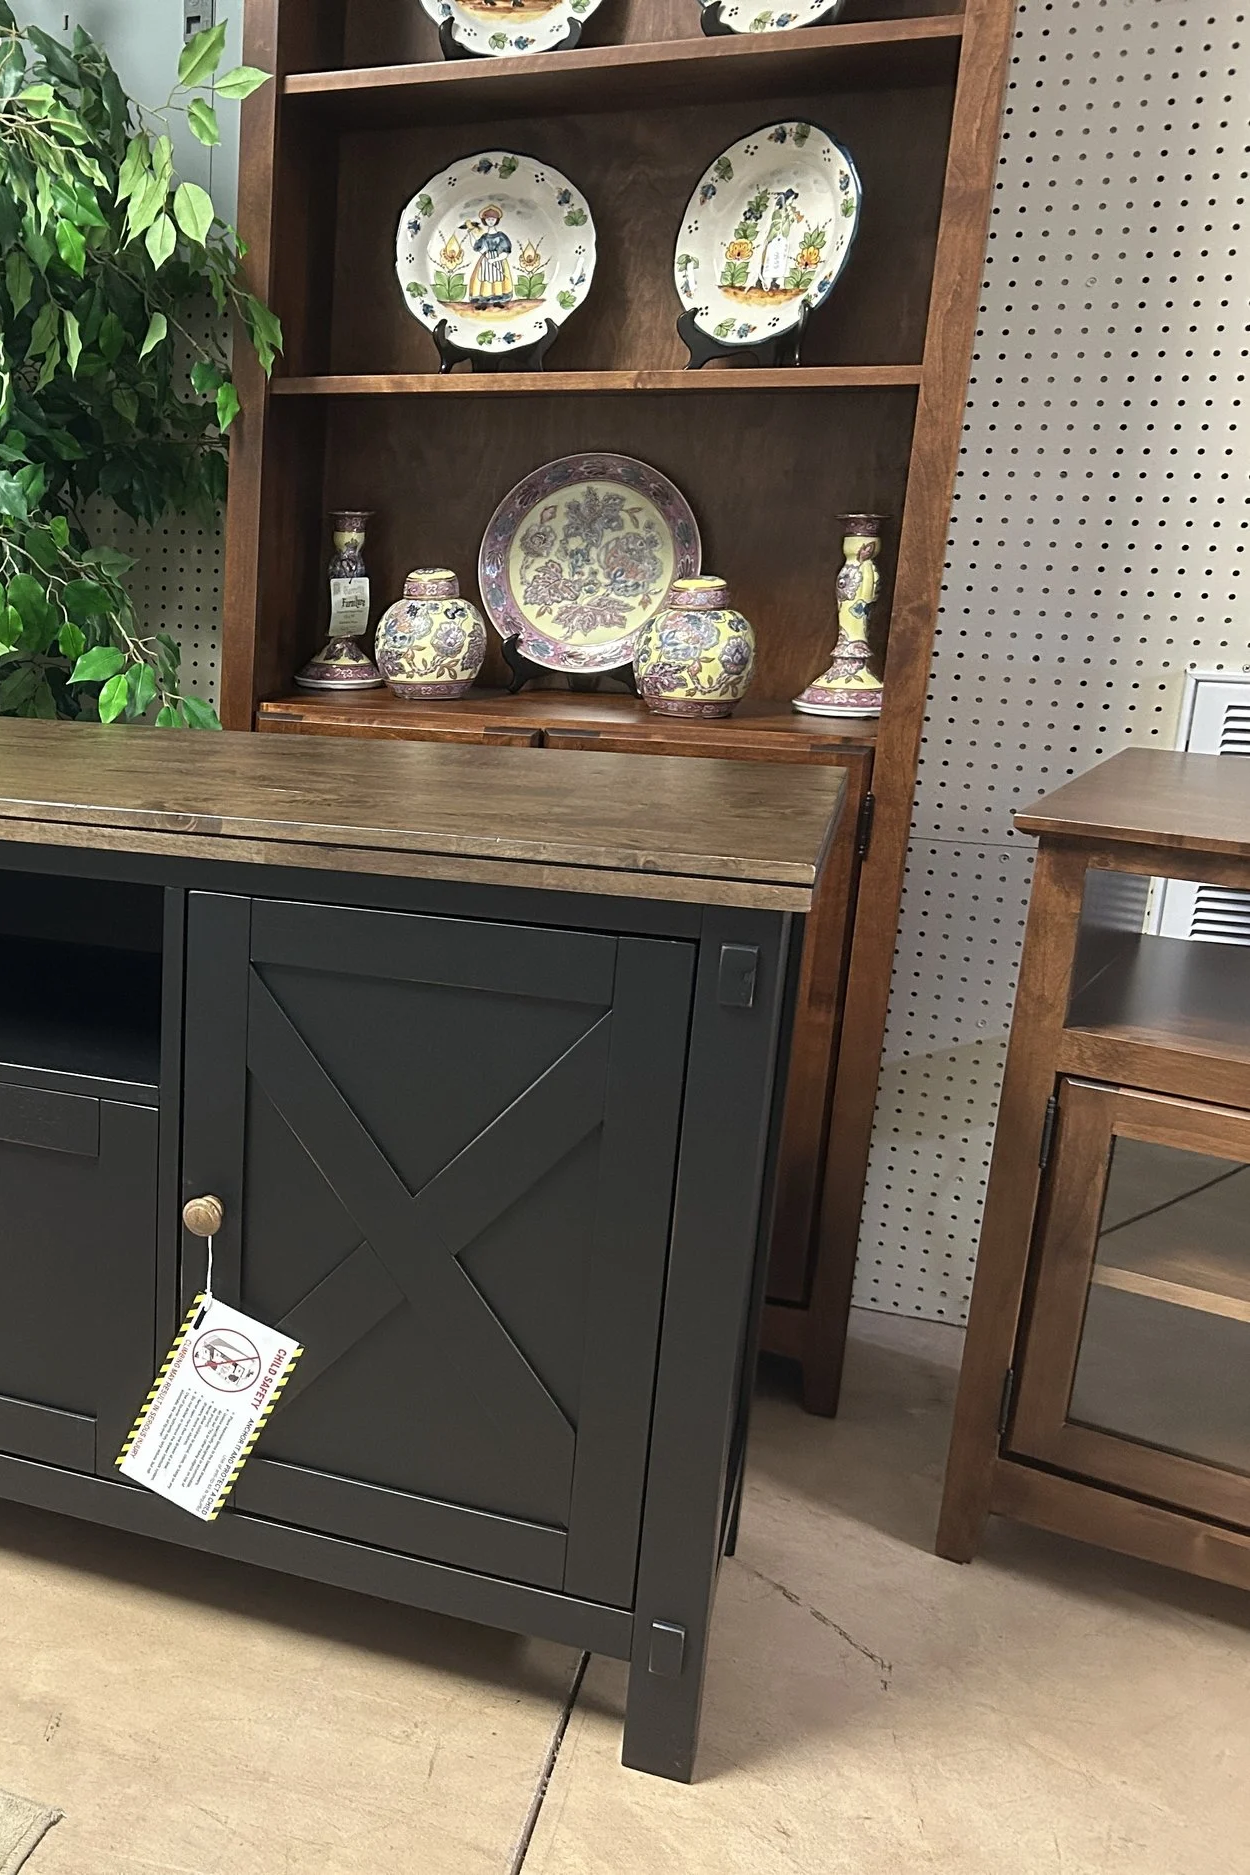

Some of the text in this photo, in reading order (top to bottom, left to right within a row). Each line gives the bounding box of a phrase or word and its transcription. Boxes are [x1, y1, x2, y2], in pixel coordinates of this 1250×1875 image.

[173, 1339, 192, 1369] CLIMBING
[167, 1368, 178, 1382] MAY
[250, 1348, 287, 1410] CHILD SAFETY
[156, 1380, 172, 1405] RESULT
[139, 1410, 157, 1438] SERIOUS
[237, 1417, 254, 1445] ANCHOR
[130, 1436, 144, 1459] INJURY
[227, 1450, 238, 1464] AND
[234, 1444, 242, 1452] IT
[213, 1464, 231, 1493] PROTECT
[200, 1496, 214, 1516] CHILD
